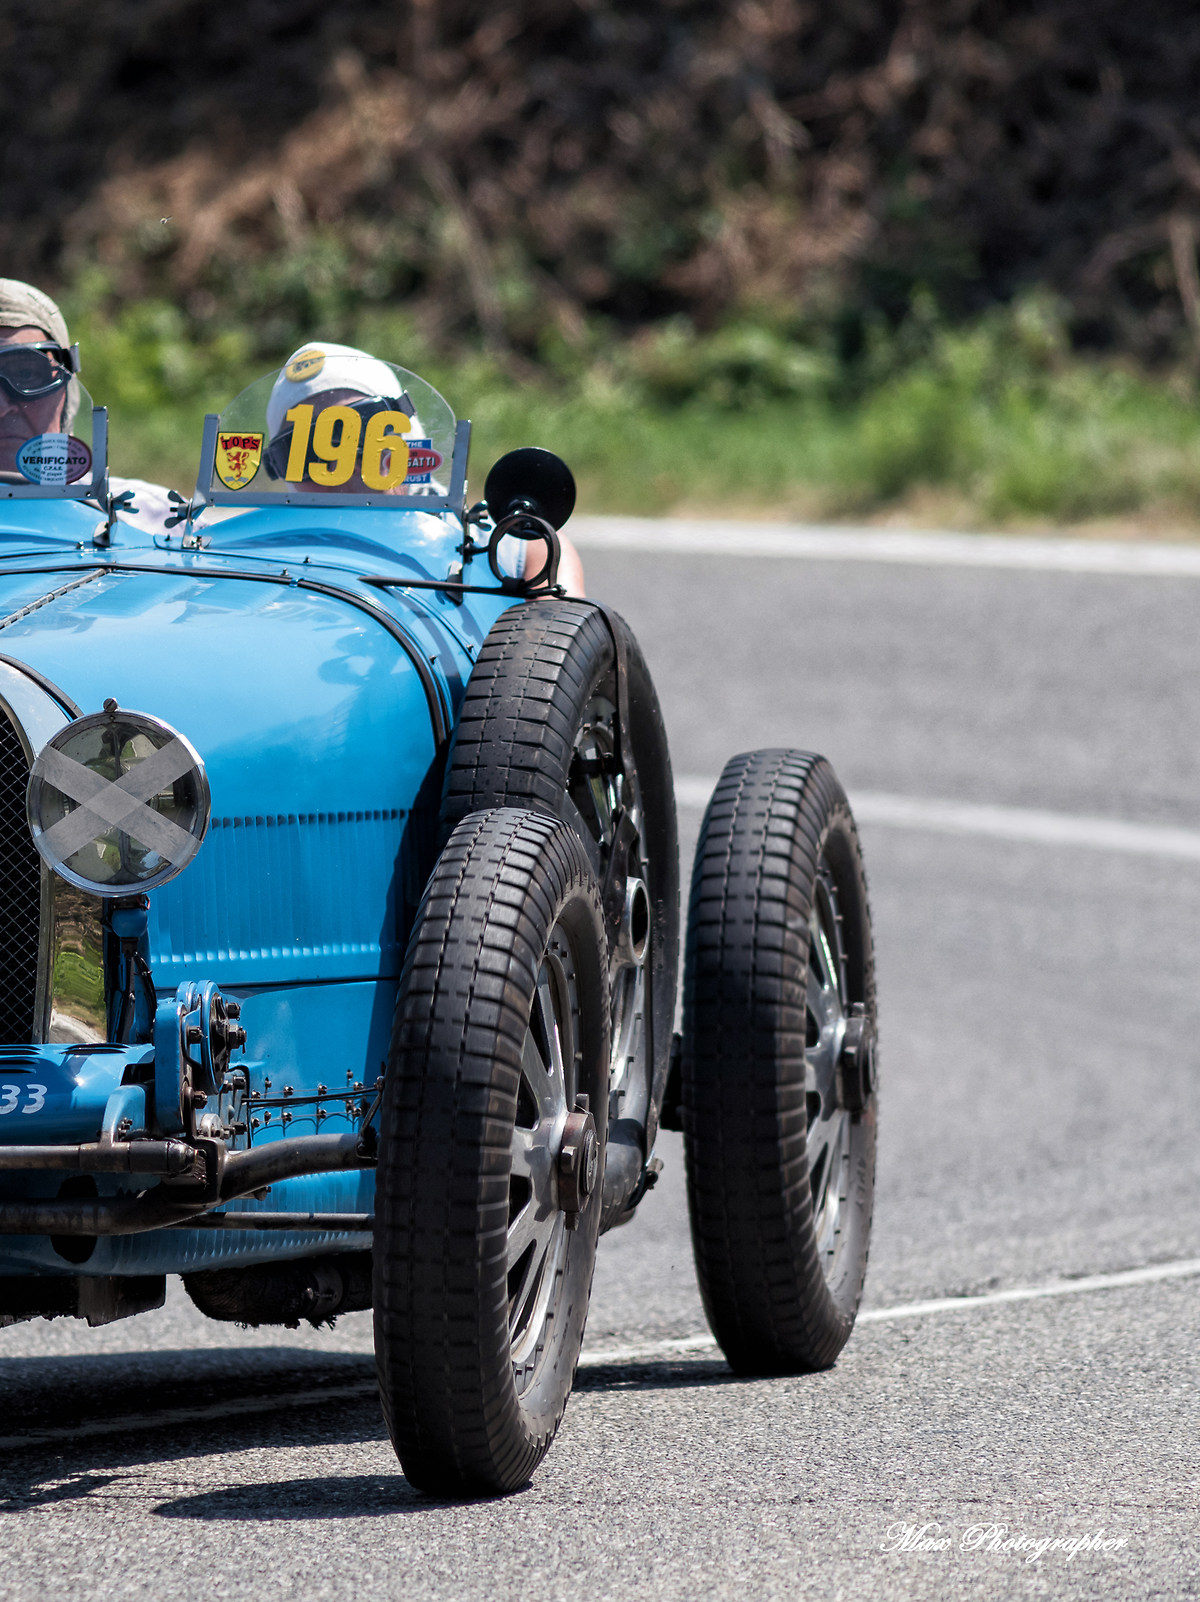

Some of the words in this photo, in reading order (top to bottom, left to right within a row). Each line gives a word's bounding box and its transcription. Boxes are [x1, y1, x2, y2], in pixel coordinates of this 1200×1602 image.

[221, 436, 258, 450] TOPS
[285, 404, 412, 491] 196
[22, 456, 87, 465] VERIFICATO
[407, 457, 435, 468] GATTI
[405, 474, 428, 482] RUST
